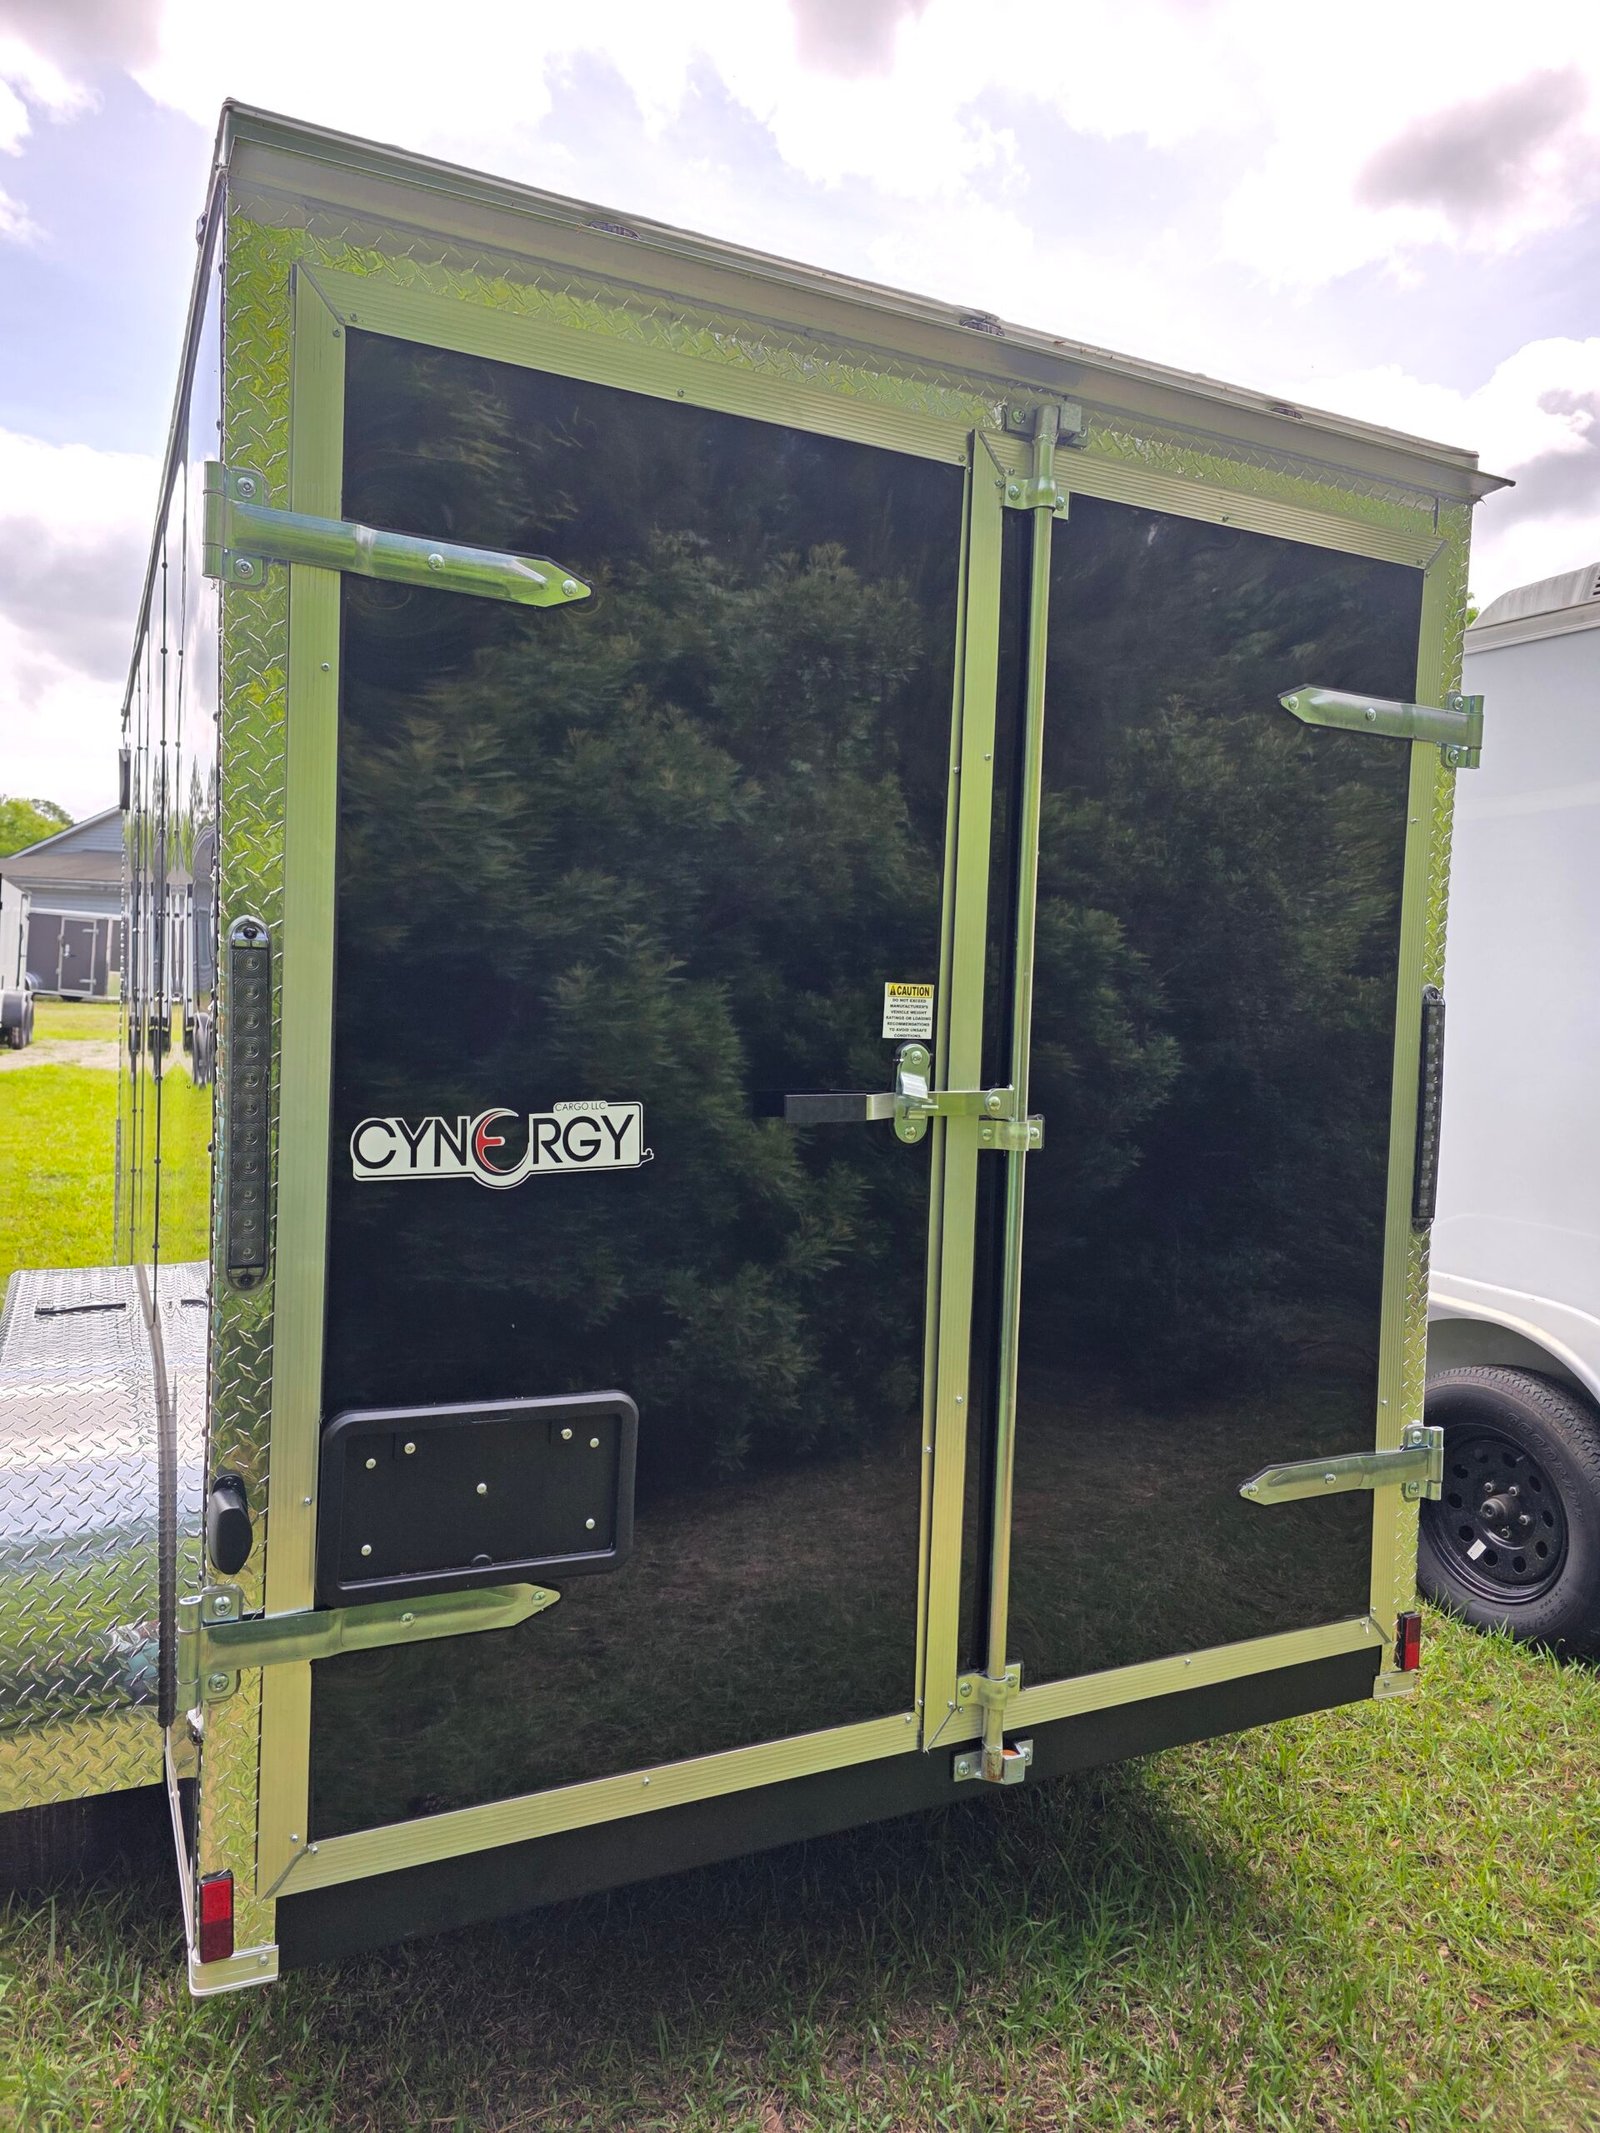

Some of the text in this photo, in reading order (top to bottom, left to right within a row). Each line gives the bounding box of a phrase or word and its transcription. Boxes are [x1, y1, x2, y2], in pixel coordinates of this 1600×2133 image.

[897, 986, 930, 996] CAUTION
[555, 1101, 606, 1111] CARGO LLC
[352, 1109, 634, 1175] CYNERGY
